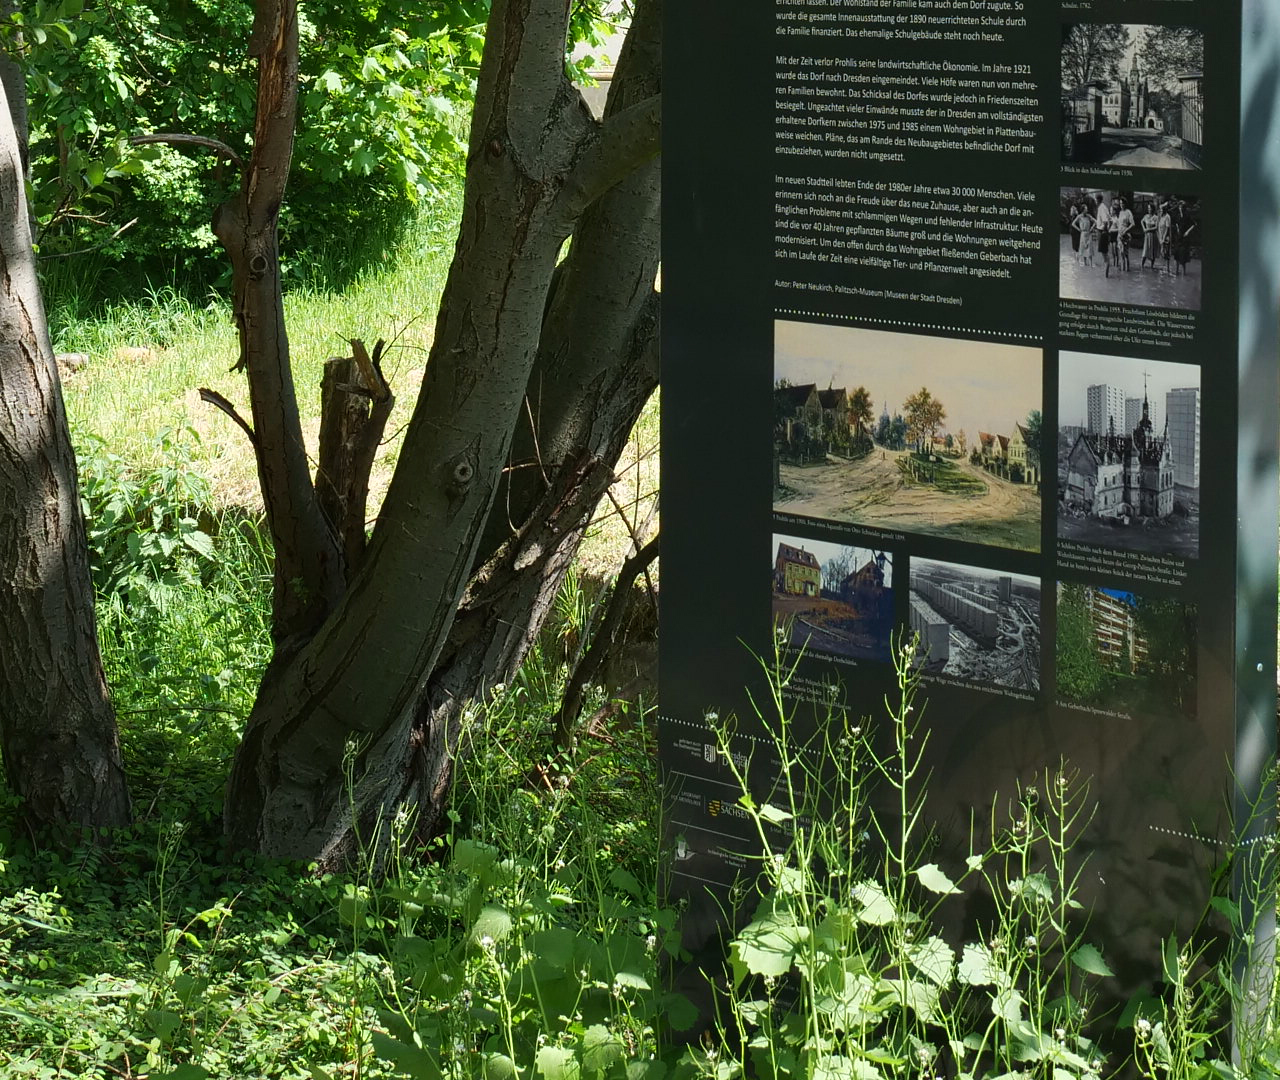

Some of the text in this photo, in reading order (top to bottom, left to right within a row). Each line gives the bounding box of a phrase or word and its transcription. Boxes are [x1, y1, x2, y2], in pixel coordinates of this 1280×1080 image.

[775, 55, 1031, 74] Mit der Zeit verlor Prohlis seine landwirtschaftliche Ökonomie. Im Jahre 1921
[774, 99, 1044, 123] besiegelt. Ungeachtet vieler Einwände musste der in Dresden am vollständigsten
[774, 144, 905, 162] einzubeziehen, wurden nicht umgesetzt.
[774, 174, 1035, 201] Im neuen Stadtteil lebten Ende der 1980er Jahre etwa 30 000 Menschen. Viele
[720, 806, 750, 820] SACHSEN
